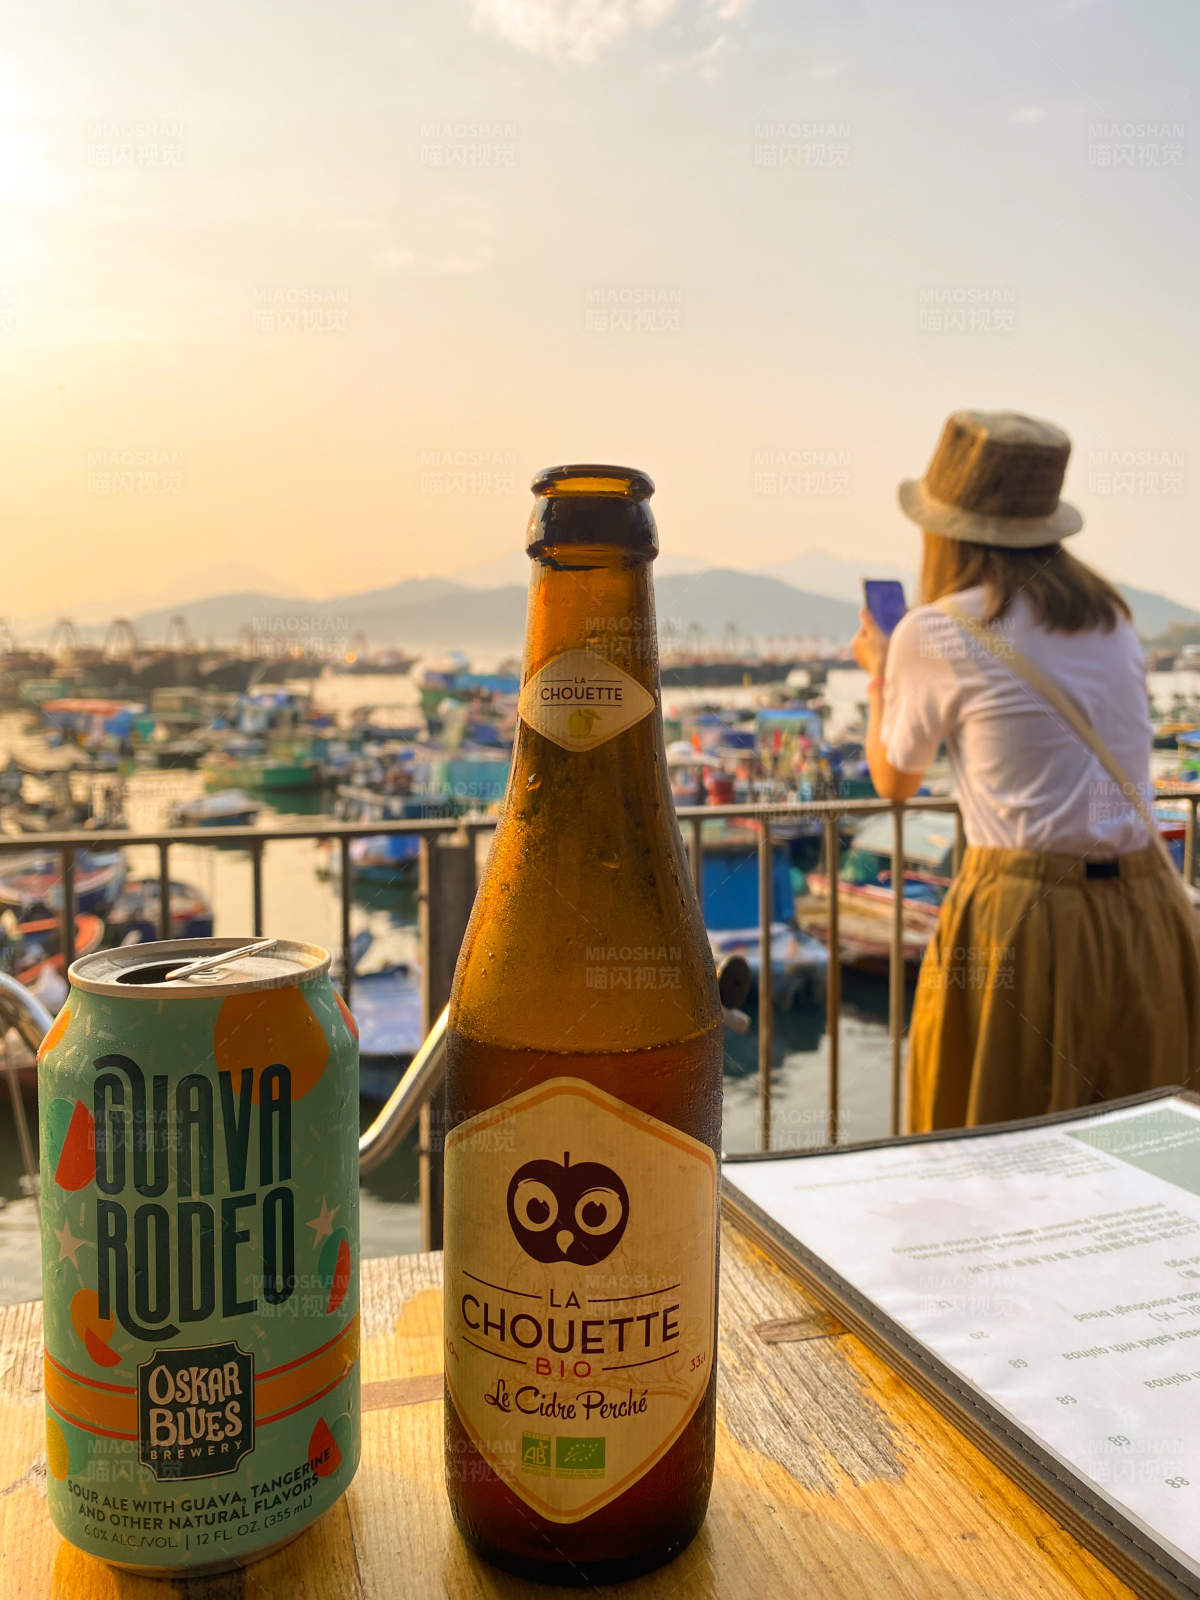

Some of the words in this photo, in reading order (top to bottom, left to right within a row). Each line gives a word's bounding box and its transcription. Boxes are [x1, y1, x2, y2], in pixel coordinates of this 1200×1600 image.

[541, 687, 623, 700] CHOUETTE
[574, 676, 586, 684] LA
[93, 1054, 291, 1198] GUAVA
[97, 1186, 295, 1342] RODEO
[550, 1288, 581, 1309] LA
[462, 1294, 680, 1354] CHOUETTE
[148, 1361, 243, 1405] OSKAR
[536, 1357, 591, 1378] BIO
[1143, 1372, 1192, 1389] quinoa
[484, 1379, 511, 1412] Le
[515, 1386, 577, 1420] Cidre
[576, 1389, 648, 1420] Perché
[149, 1400, 243, 1447] BLUES
[1108, 1434, 1131, 1447] 68
[150, 1440, 242, 1460] BREWERY
[67, 1480, 99, 1504] SOUR
[102, 1496, 129, 1512] ALE
[132, 1499, 175, 1514] WITH
[181, 1491, 247, 1512] GUAVA,
[250, 1447, 331, 1498] TANGERINE
[1164, 1475, 1191, 1489] 88
[78, 1503, 106, 1522] AND
[110, 1513, 163, 1530] OTHER
[169, 1506, 250, 1530] NATURAL
[254, 1472, 319, 1514] FLAVORS
[196, 1533, 209, 1545] 12
[264, 1510, 291, 1529] (355
